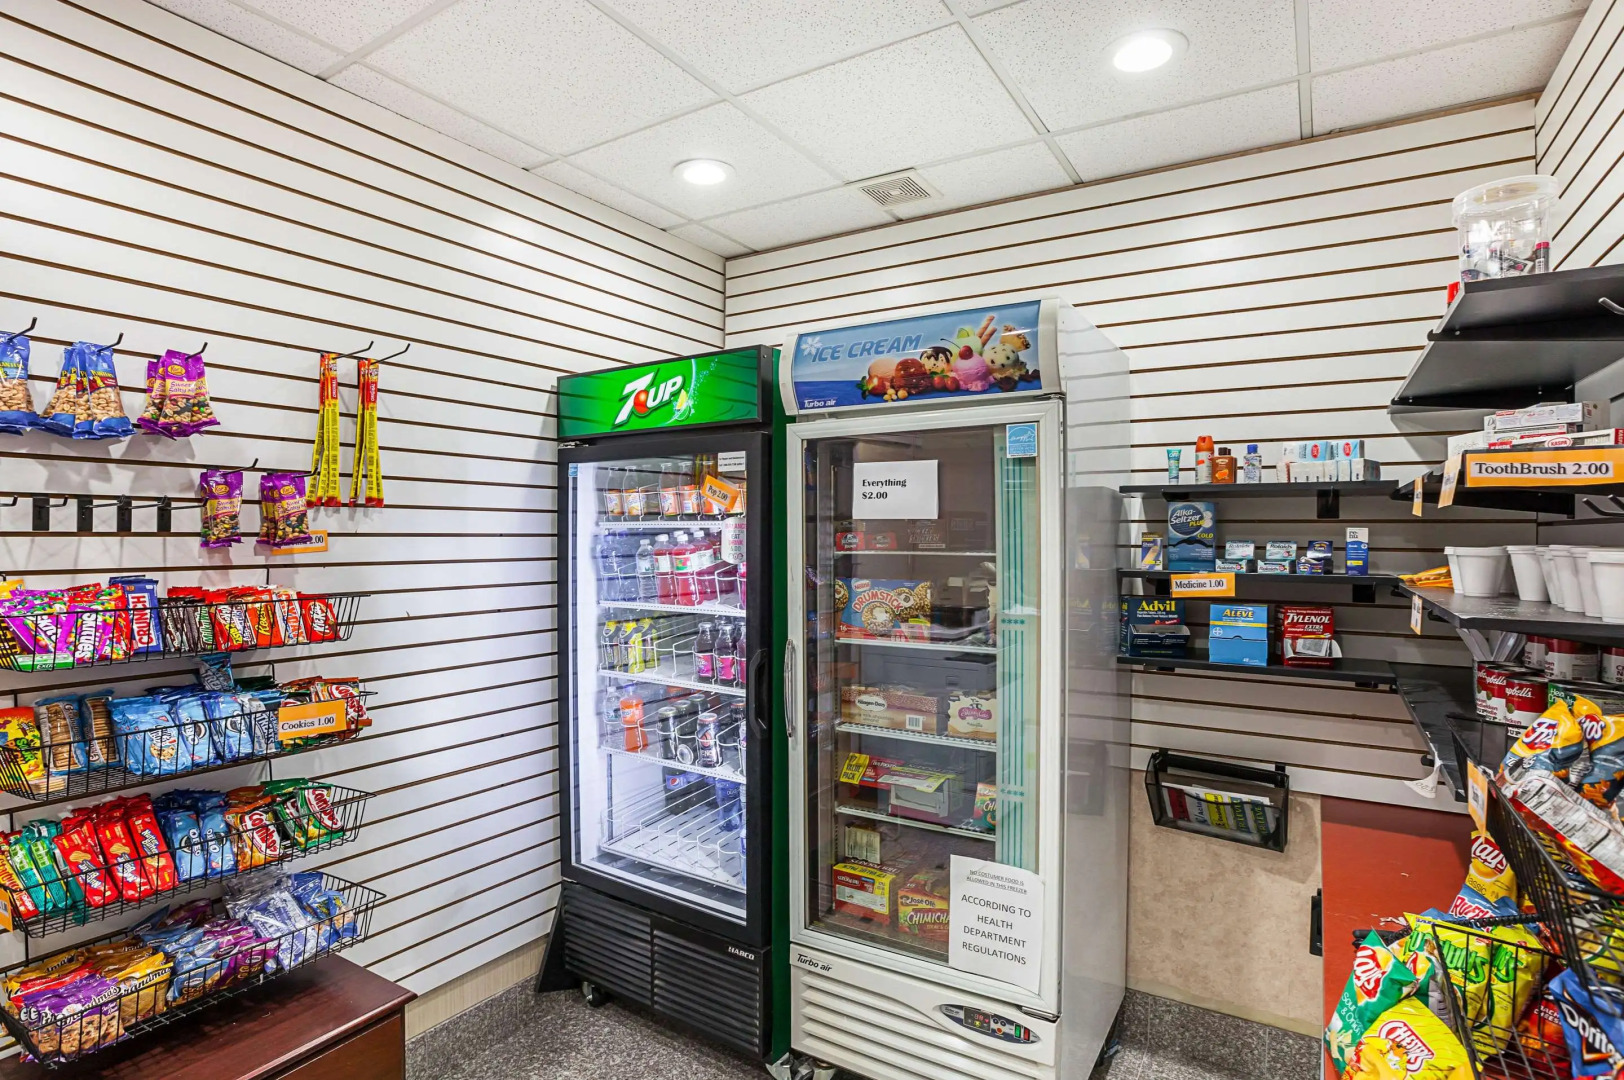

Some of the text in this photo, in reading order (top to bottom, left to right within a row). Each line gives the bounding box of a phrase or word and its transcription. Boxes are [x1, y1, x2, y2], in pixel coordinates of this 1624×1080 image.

[812, 334, 922, 362] ICE CREAM
[804, 399, 824, 408] Turbo
[1475, 462, 1610, 475] ToothBrush 2.00
[862, 479, 907, 488] Everything
[708, 485, 729, 502] Pop 2.00
[862, 491, 888, 499] $2.00
[1170, 515, 1201, 525] Seltzer
[1172, 509, 1196, 518] Alka-
[1174, 579, 1224, 589] Medicine 1.00
[852, 590, 904, 614] DRUMSTICK
[1137, 601, 1176, 611] Advil
[131, 595, 155, 646] CRUNCH
[1223, 609, 1254, 618] ALEVE
[1286, 612, 1331, 624] TYLENOL
[74, 613, 96, 660] Skittles
[281, 716, 335, 732] Cookies 1.00
[841, 772, 856, 780] PACK
[189, 828, 200, 857] OREO
[966, 876, 990, 887] ALLOWED
[996, 882, 1007, 891] THIS
[1007, 885, 1028, 895] FREEZER
[978, 871, 1004, 881] COSTUMER
[1005, 877, 1018, 885] FOOD
[961, 894, 1032, 918] ACCORDING TO
[977, 914, 1013, 930] HEALTH
[963, 926, 1027, 948] DEPARTMENT
[728, 946, 755, 960] HABCO
[962, 941, 1027, 965] REGULATIONS
[797, 953, 833, 972] Turbo air
[1341, 992, 1356, 1012] Sour
[1345, 1012, 1361, 1036] Onion
